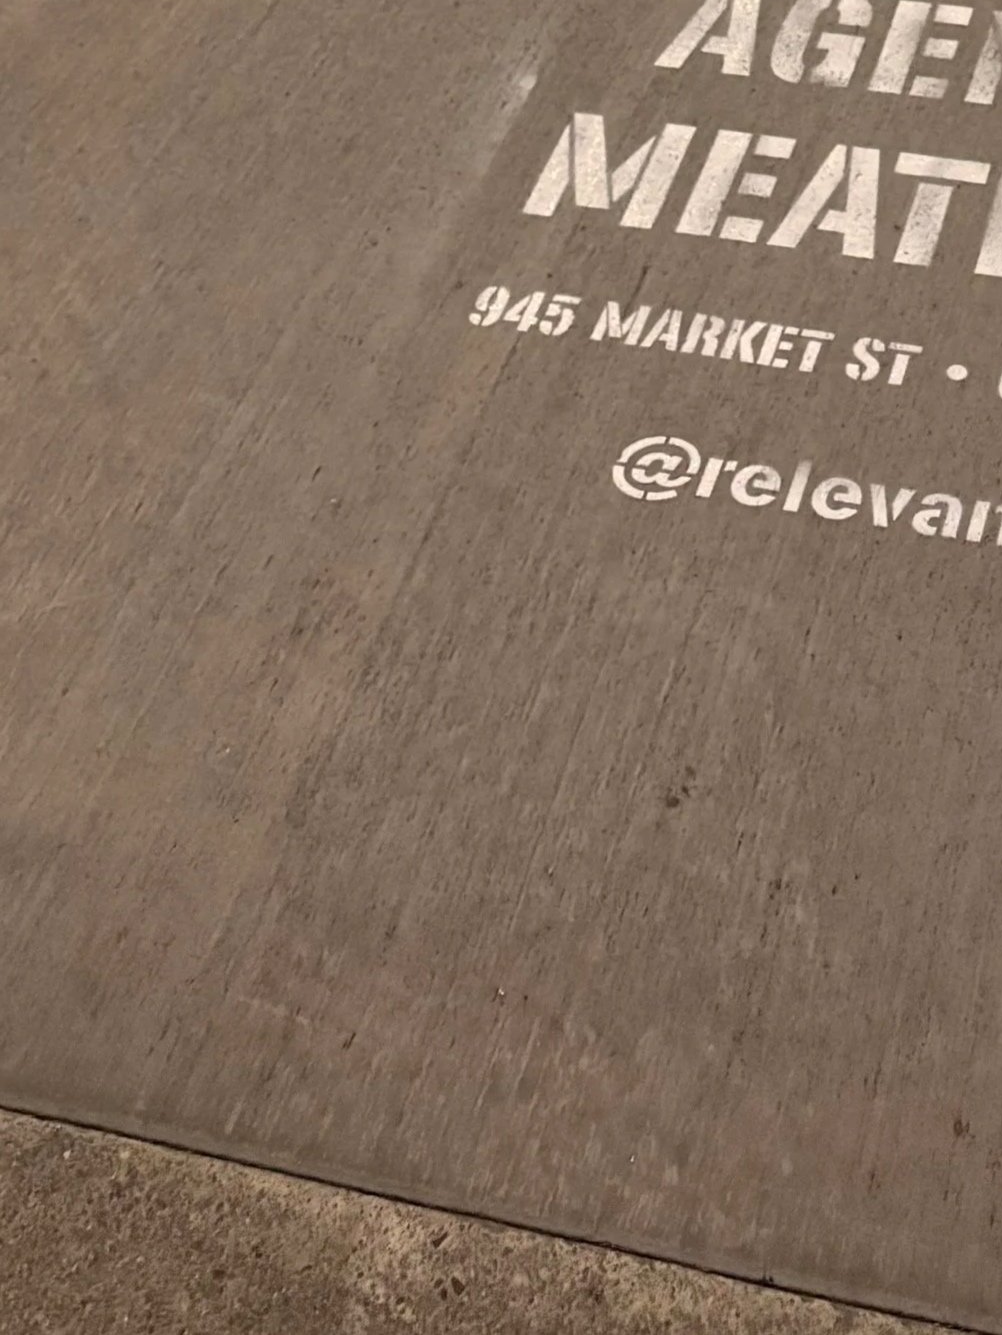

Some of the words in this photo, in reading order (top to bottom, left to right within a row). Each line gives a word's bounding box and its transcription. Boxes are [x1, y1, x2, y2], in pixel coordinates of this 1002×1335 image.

[468, 284, 582, 338] 945
[588, 300, 836, 375] MARKET
[844, 336, 924, 387] ST
